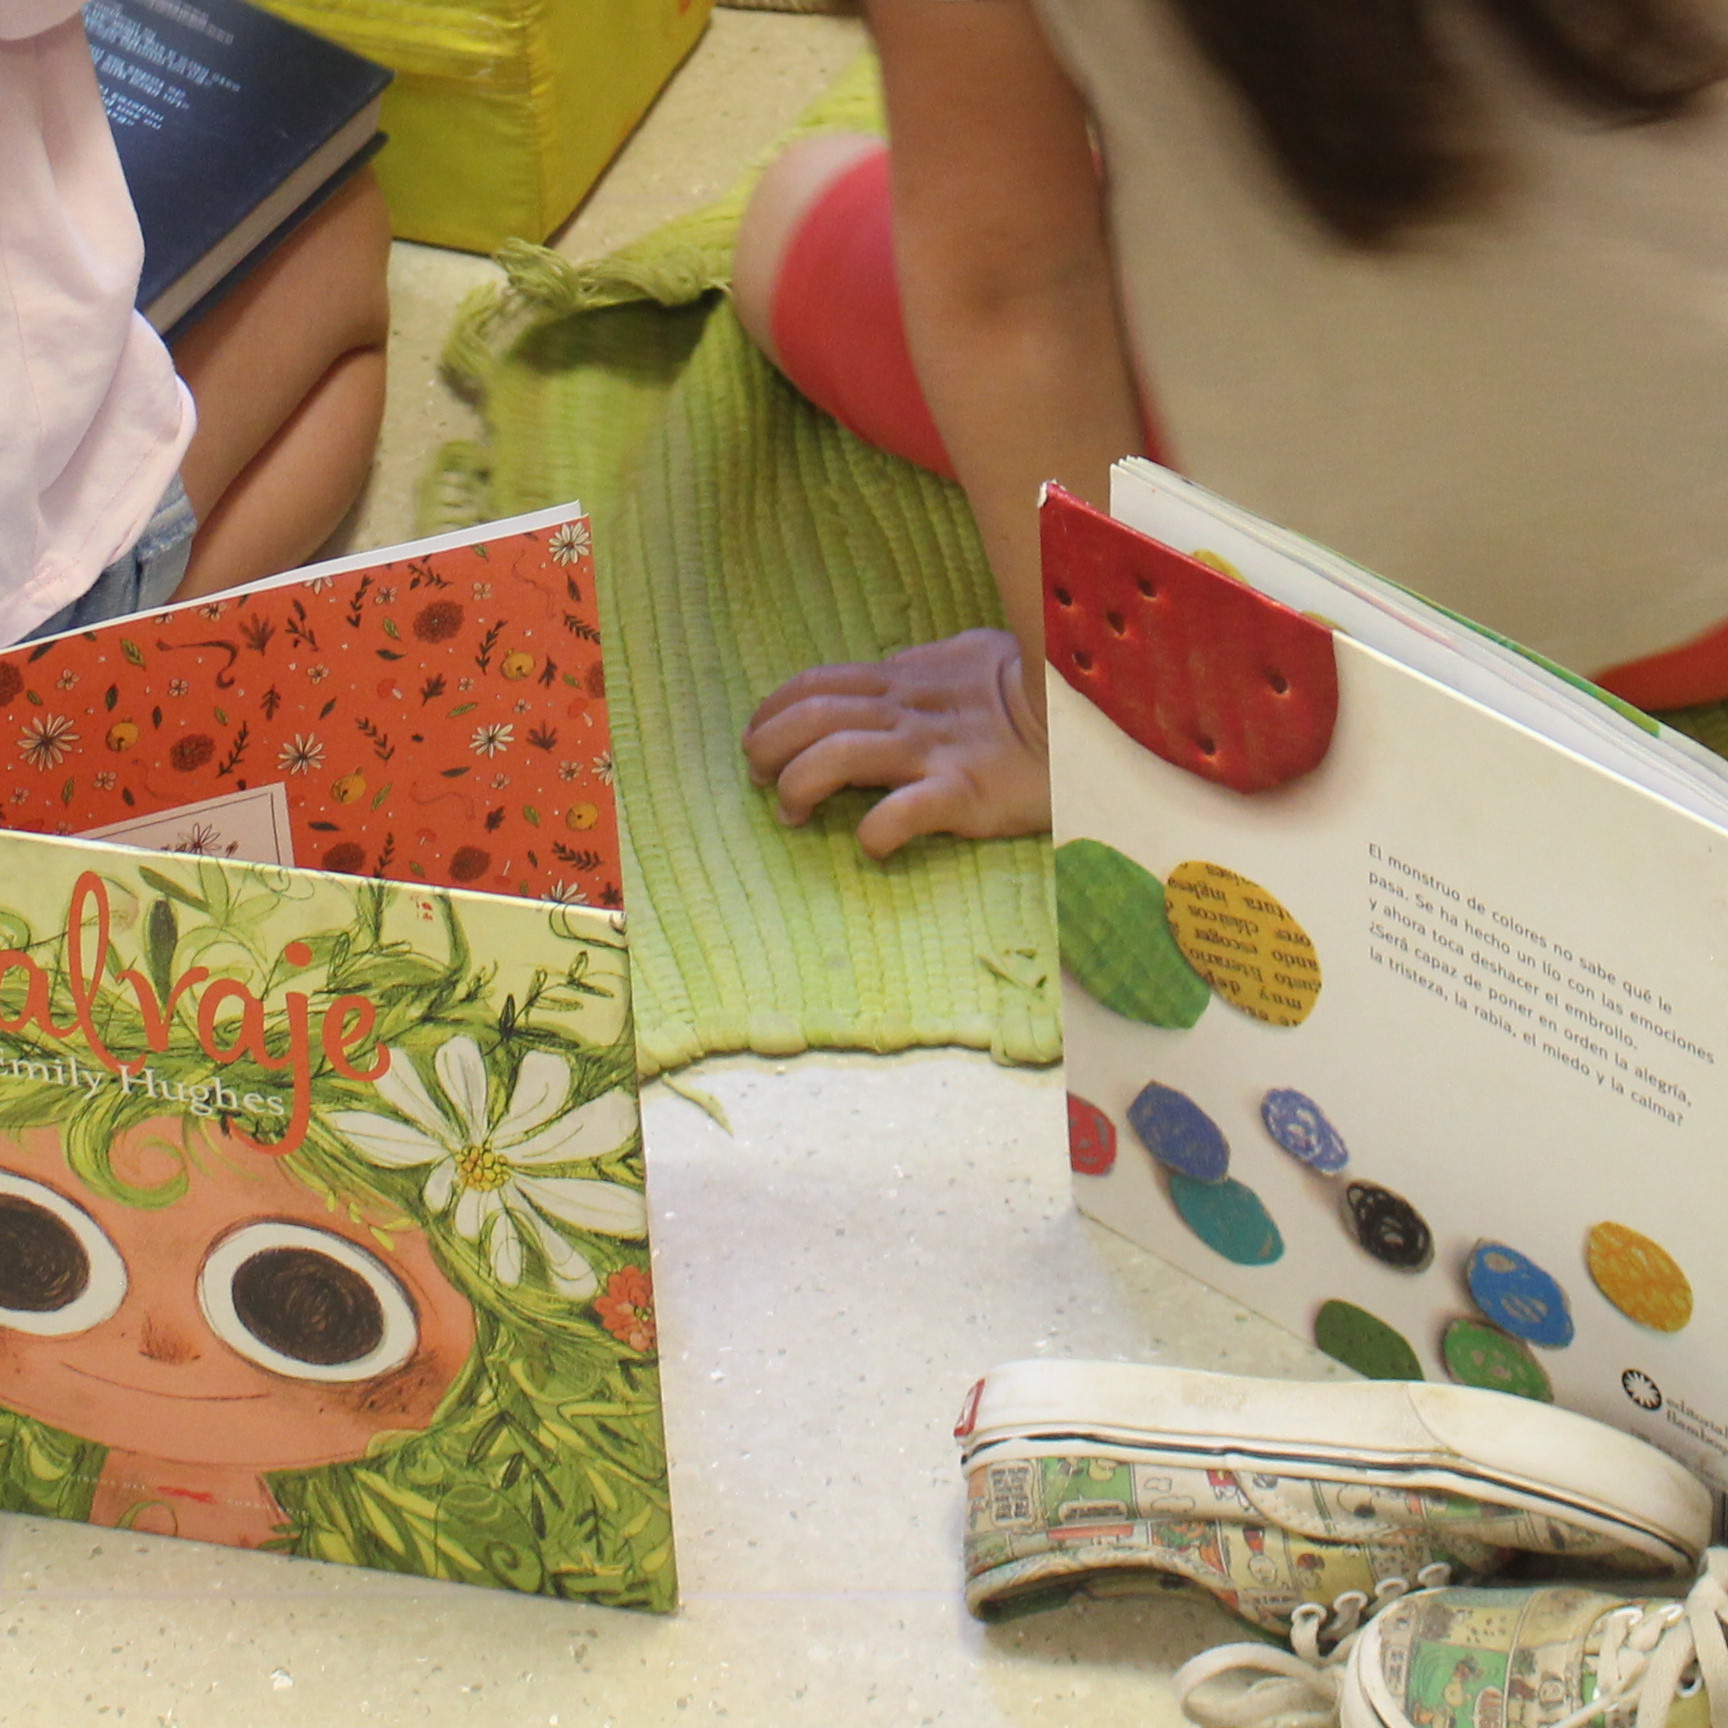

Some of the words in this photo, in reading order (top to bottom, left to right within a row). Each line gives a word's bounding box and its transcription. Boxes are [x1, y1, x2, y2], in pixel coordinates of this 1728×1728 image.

[1369, 843, 1382, 860] El
[1388, 856, 1460, 901] monstruo
[1467, 897, 1485, 914] de
[1492, 911, 1547, 948] colores
[1554, 943, 1573, 961] no
[1579, 957, 1616, 984] sabe
[1623, 980, 1652, 1003] qué
[1658, 996, 1672, 1014] le
[1369, 872, 1409, 901] pasa.
[1415, 893, 1434, 913] Se
[1440, 906, 1458, 926] ha
[1465, 919, 1510, 954] hecho
[1517, 951, 1536, 968] un
[1543, 961, 1561, 981] lío
[1568, 977, 1595, 1000] con
[1602, 992, 1623, 1014] las
[1630, 1010, 1715, 1065] emociones
[1369, 898, 1377, 912] y
[1383, 906, 1426, 936] ahora
[1432, 930, 1464, 956] toca
[1471, 951, 1539, 996] deshacer
[1545, 992, 1559, 1006] el
[1565, 1002, 1638, 1050] embrollo.
[1369, 921, 1408, 952] ¿Será
[1414, 947, 1457, 977] capaz
[1464, 973, 1482, 990] de
[1488, 987, 1534, 1018] poner
[1539, 1014, 1558, 1032] en
[1564, 1029, 1609, 1060] orden
[1614, 1052, 1628, 1070] la
[1634, 1065, 1692, 1107] alegría,
[118, 1064, 285, 1116] Hughes
[1370, 946, 1383, 964] la
[1388, 957, 1449, 1001] tristeza,
[1454, 991, 1468, 1010] la
[1474, 1005, 1517, 1038] rabia,
[1522, 1031, 1537, 1047] el
[1543, 1042, 1590, 1076] miedo
[1596, 1071, 1605, 1085] y
[1611, 1076, 1624, 1094] la
[1631, 1091, 1684, 1127] calma?
[1667, 1398, 1728, 1439] editorial
